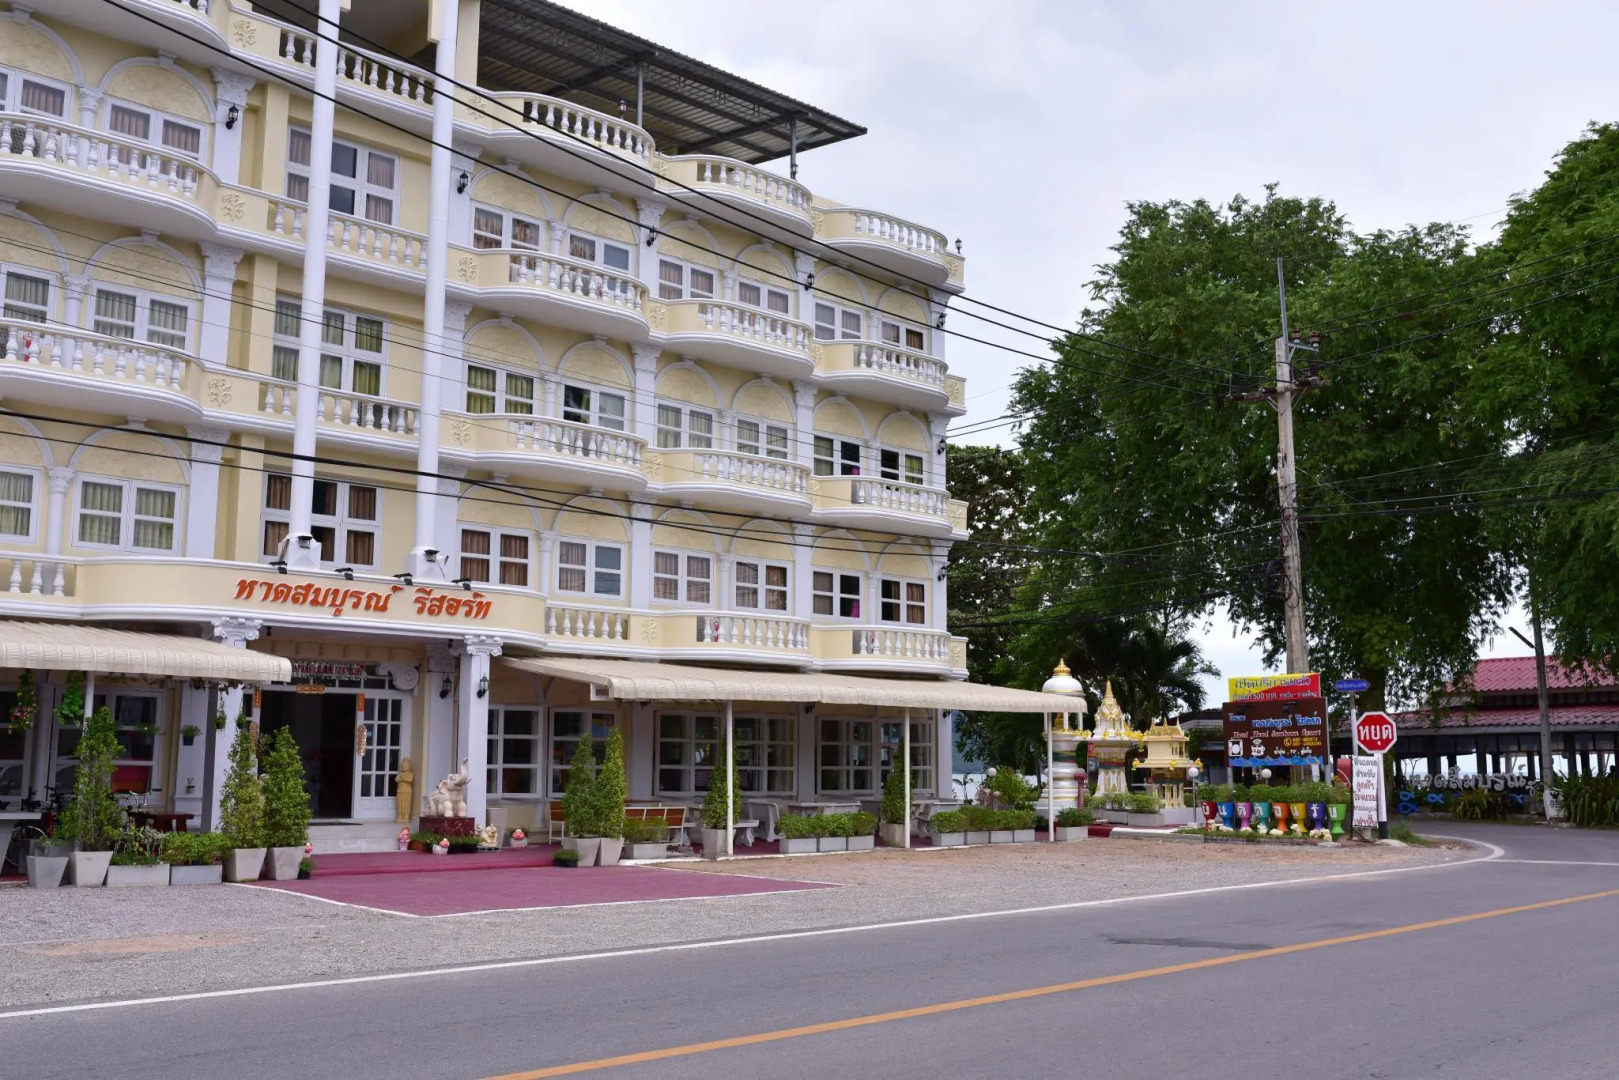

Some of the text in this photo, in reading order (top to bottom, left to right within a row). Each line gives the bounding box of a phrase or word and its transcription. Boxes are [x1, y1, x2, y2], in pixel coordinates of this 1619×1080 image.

[234, 578, 492, 619] หาดสมบูรณ์ รีสอร์ท
[1359, 724, 1392, 746] หยุด
[1409, 764, 1527, 791] หาดสมบรณ์
